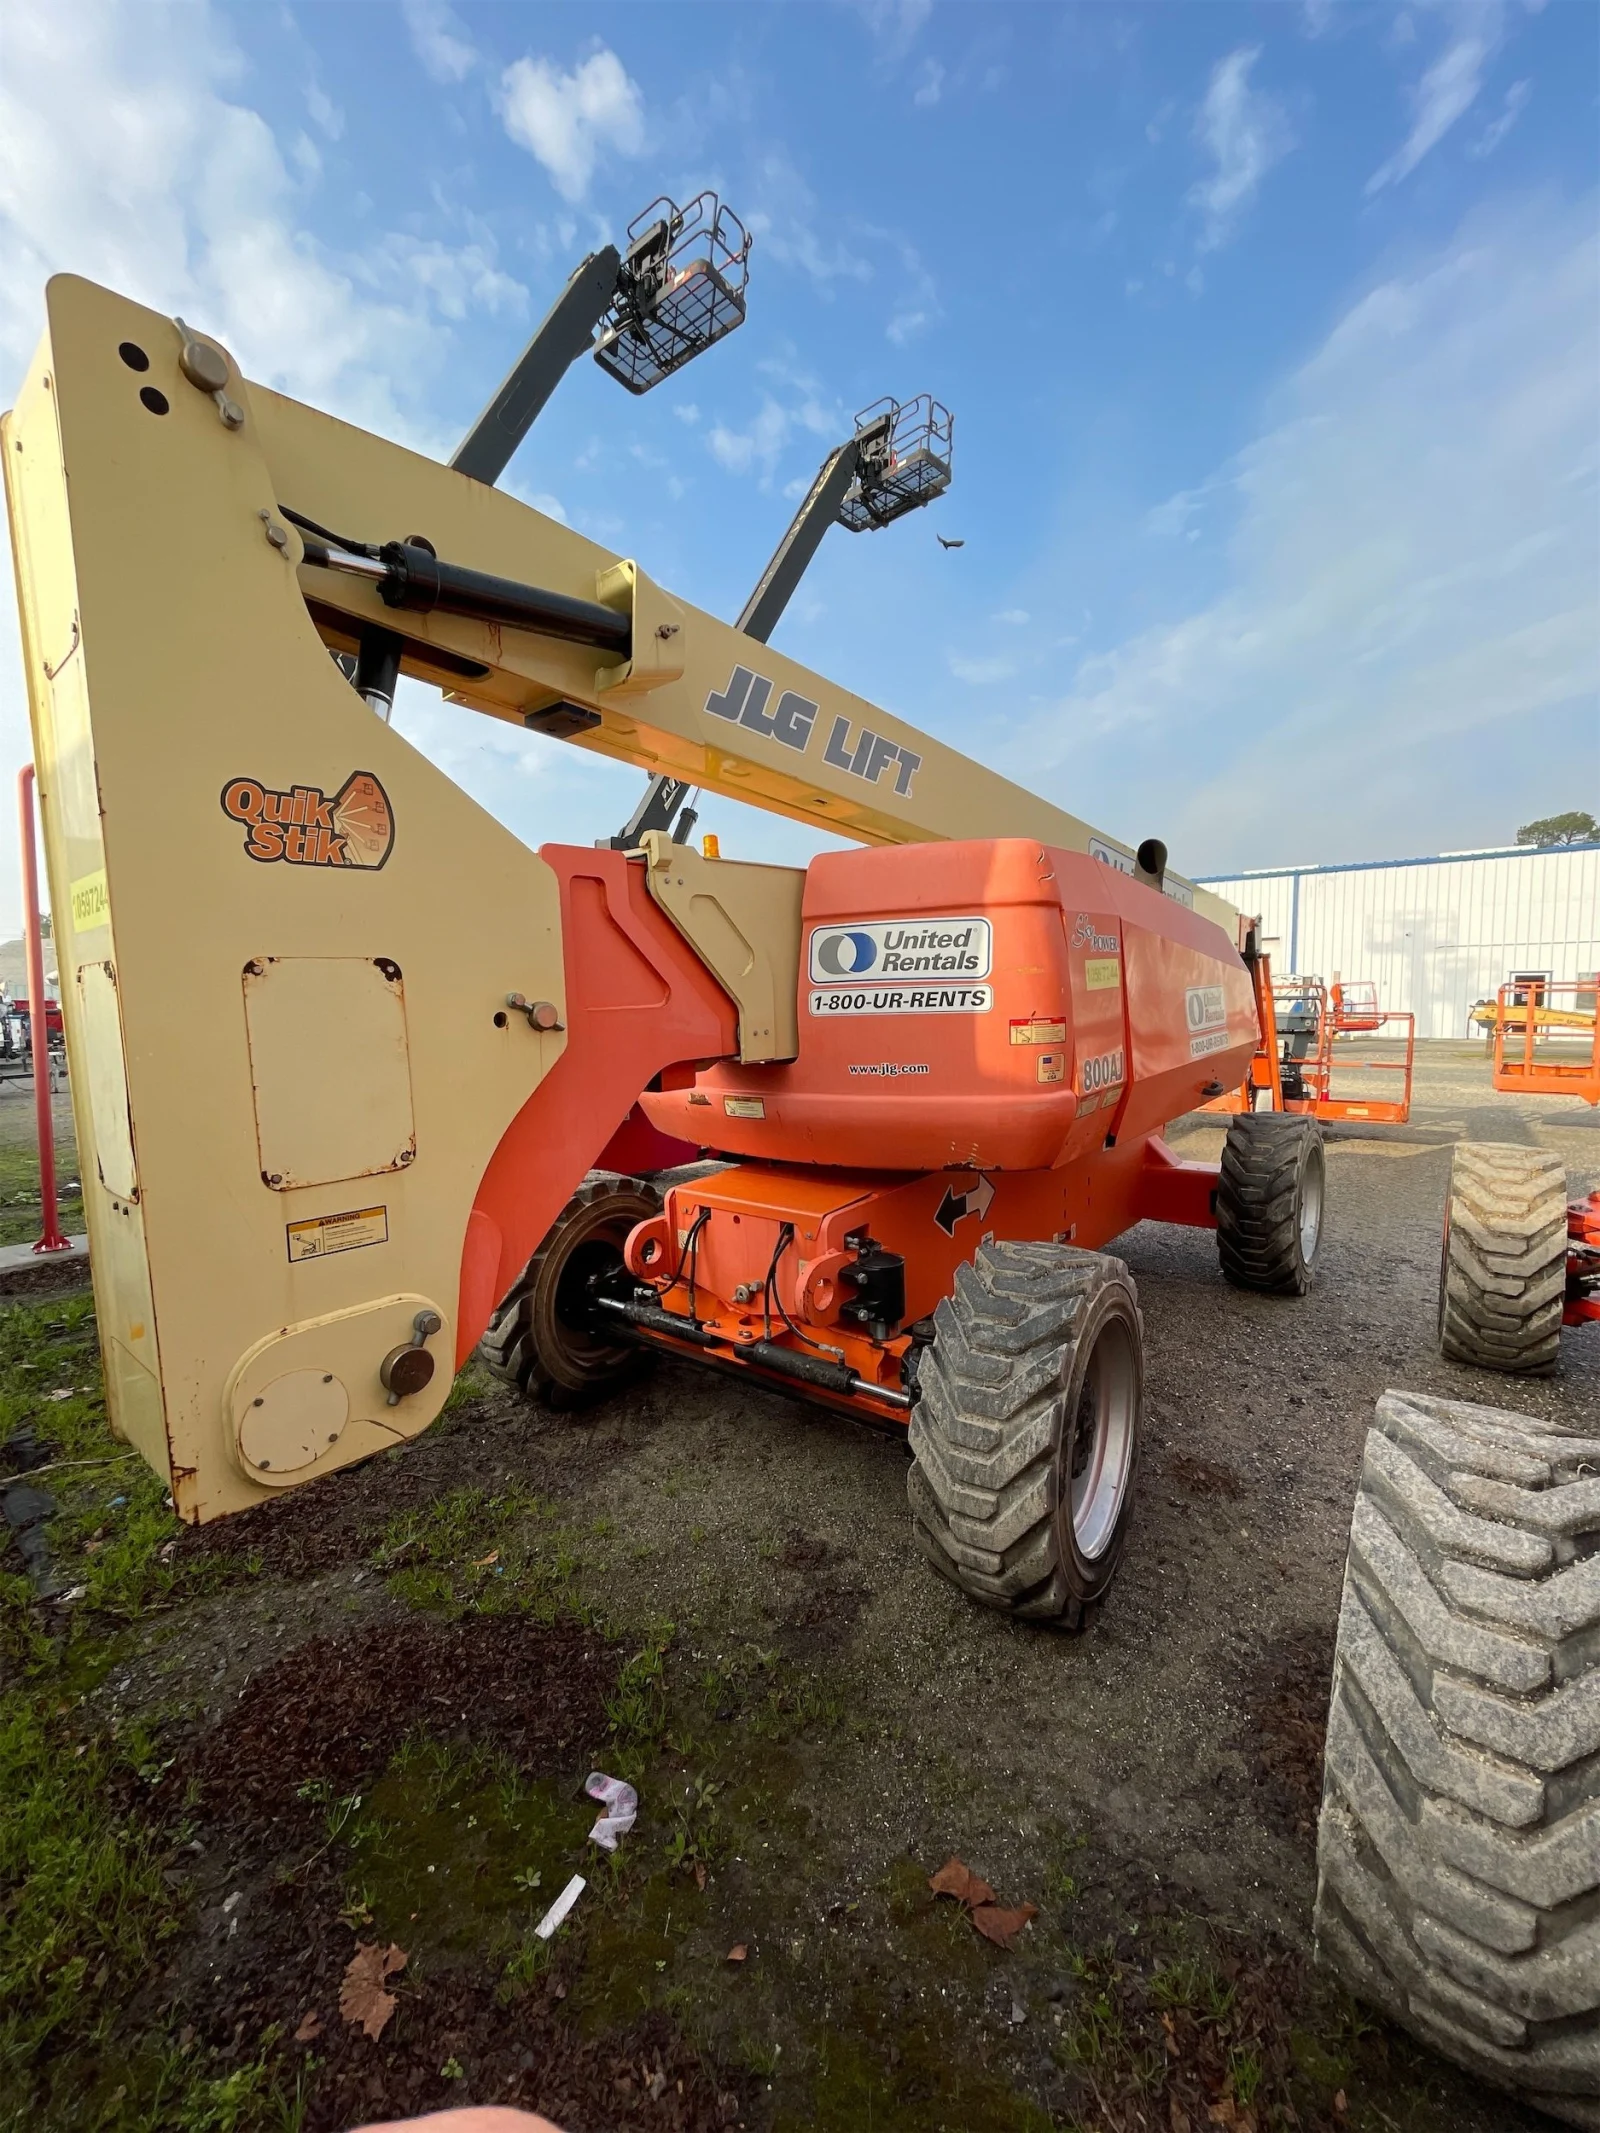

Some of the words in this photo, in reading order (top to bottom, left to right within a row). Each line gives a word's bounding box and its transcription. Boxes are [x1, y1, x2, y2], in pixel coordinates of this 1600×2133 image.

[704, 664, 820, 752] JLG
[821, 714, 922, 797] LIFT
[225, 781, 335, 829] Quik
[249, 822, 346, 864] Stik
[883, 928, 972, 951] United
[881, 950, 979, 972] Rentals
[814, 990, 986, 1011] 1-800-UR-RENTS
[849, 1063, 929, 1077] www.jlg.com
[1083, 1051, 1124, 1092] 800AJ
[324, 1213, 361, 1226] WARNING
